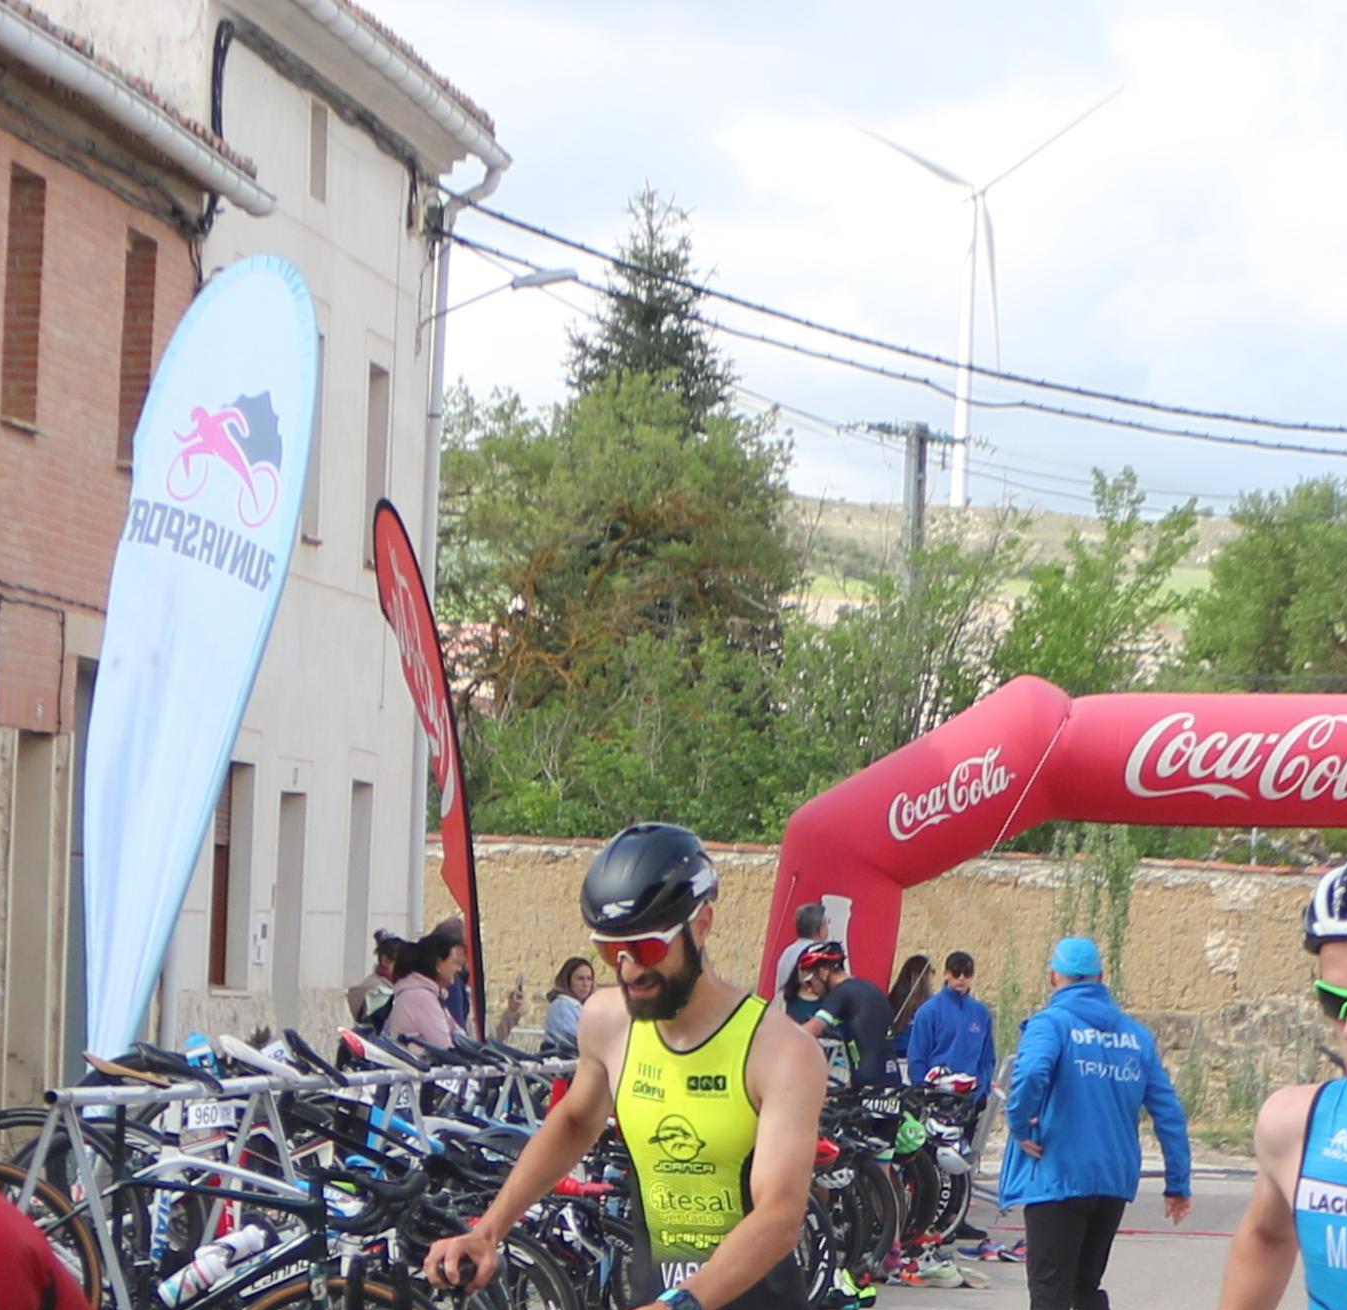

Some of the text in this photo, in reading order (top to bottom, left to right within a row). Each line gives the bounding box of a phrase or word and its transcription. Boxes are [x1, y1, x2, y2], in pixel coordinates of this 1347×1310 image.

[889, 745, 1010, 840] Coca-Cola
[1072, 1029, 1140, 1049] OFICIAL
[195, 1106, 218, 1125] 960
